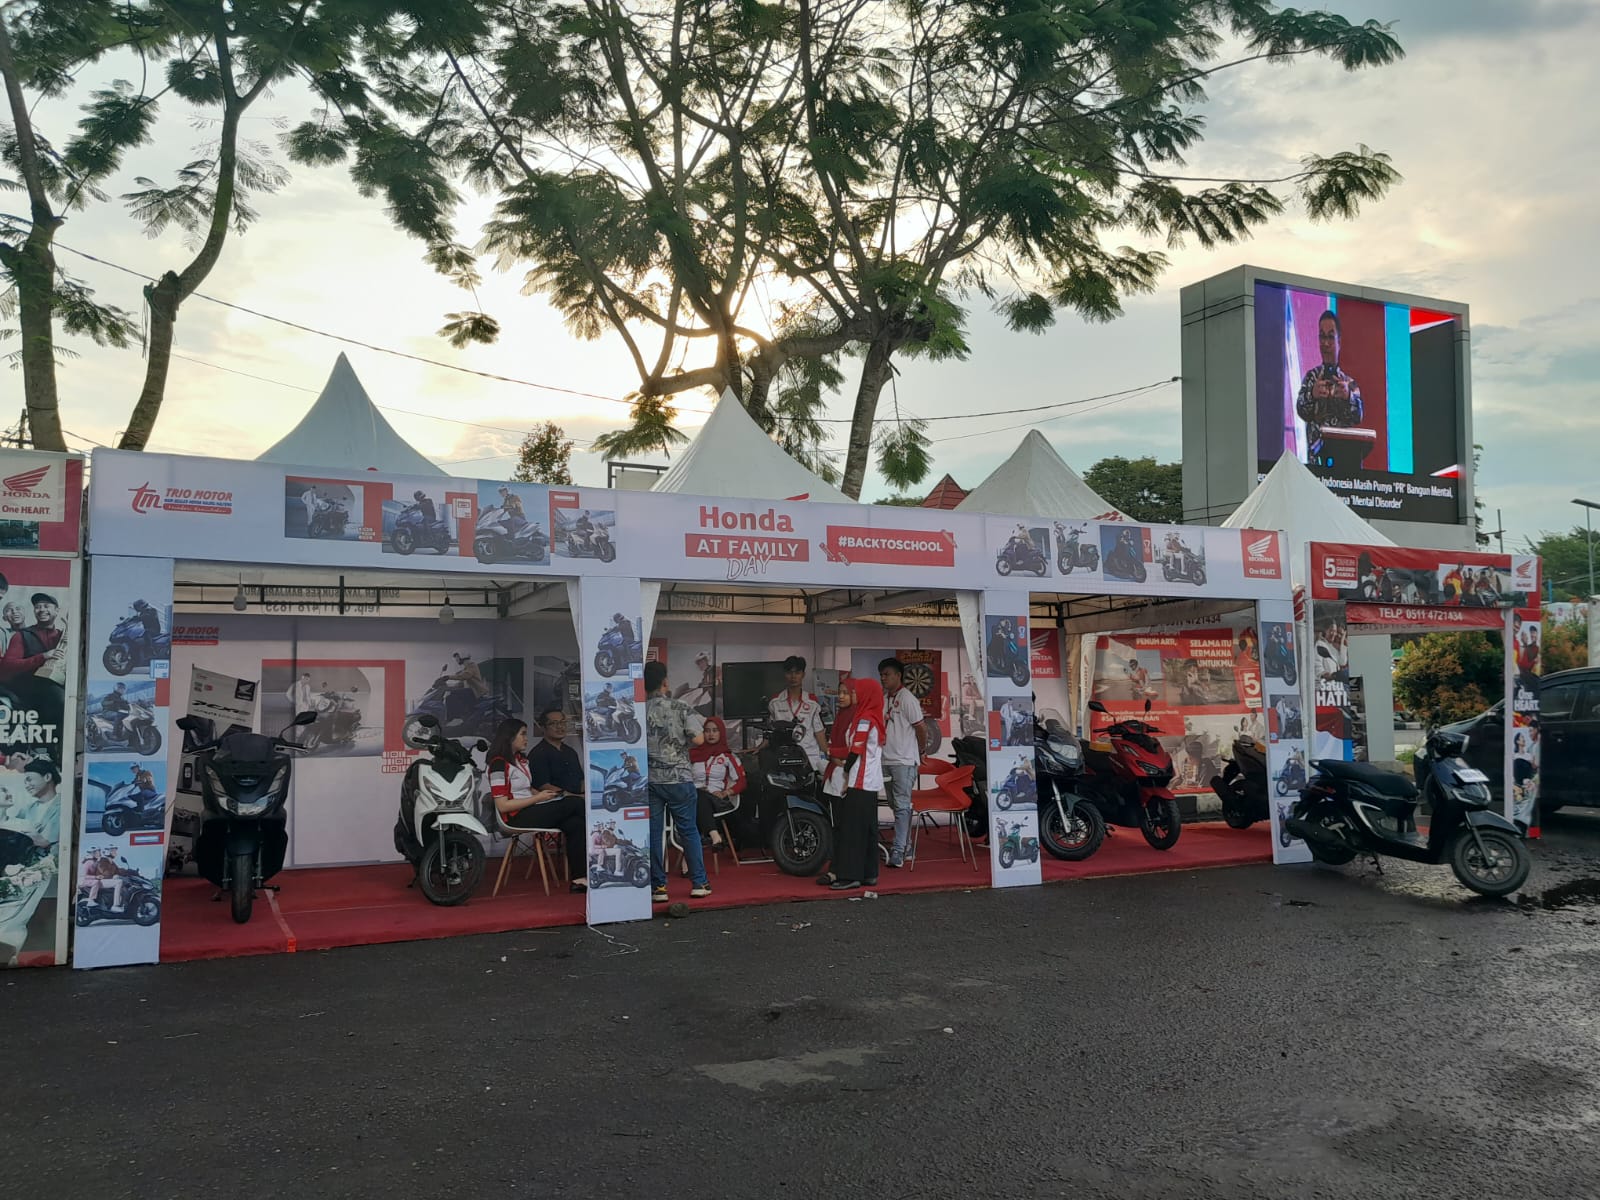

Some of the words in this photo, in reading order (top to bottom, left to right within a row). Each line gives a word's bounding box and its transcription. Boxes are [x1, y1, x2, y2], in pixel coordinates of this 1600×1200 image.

[3, 490, 50, 499] HONDA
[165, 487, 192, 499] TRIO
[193, 489, 233, 501] MOTOR
[1321, 476, 1354, 489] Indonesia
[1354, 478, 1373, 490] Masih
[1373, 480, 1393, 494] Punya
[1407, 483, 1431, 498] Bangun
[2, 504, 20, 513] One
[699, 505, 795, 532] Honda
[697, 539, 722, 554] AT
[728, 540, 799, 557] FAMILY
[838, 535, 944, 552] #BACKTOSCHOOL
[726, 554, 772, 580] DAY
[1325, 557, 1336, 577] 5
[1379, 607, 1402, 619] TELP
[1190, 639, 1221, 648] SELAMA
[1190, 649, 1232, 657] BERMAKNA
[1243, 672, 1260, 696] 5
[1320, 679, 1345, 691] Satu
[1316, 691, 1350, 707] HATI.
[1518, 686, 1534, 700] One
[0, 704, 39, 724] One
[0, 724, 59, 744] EART.
